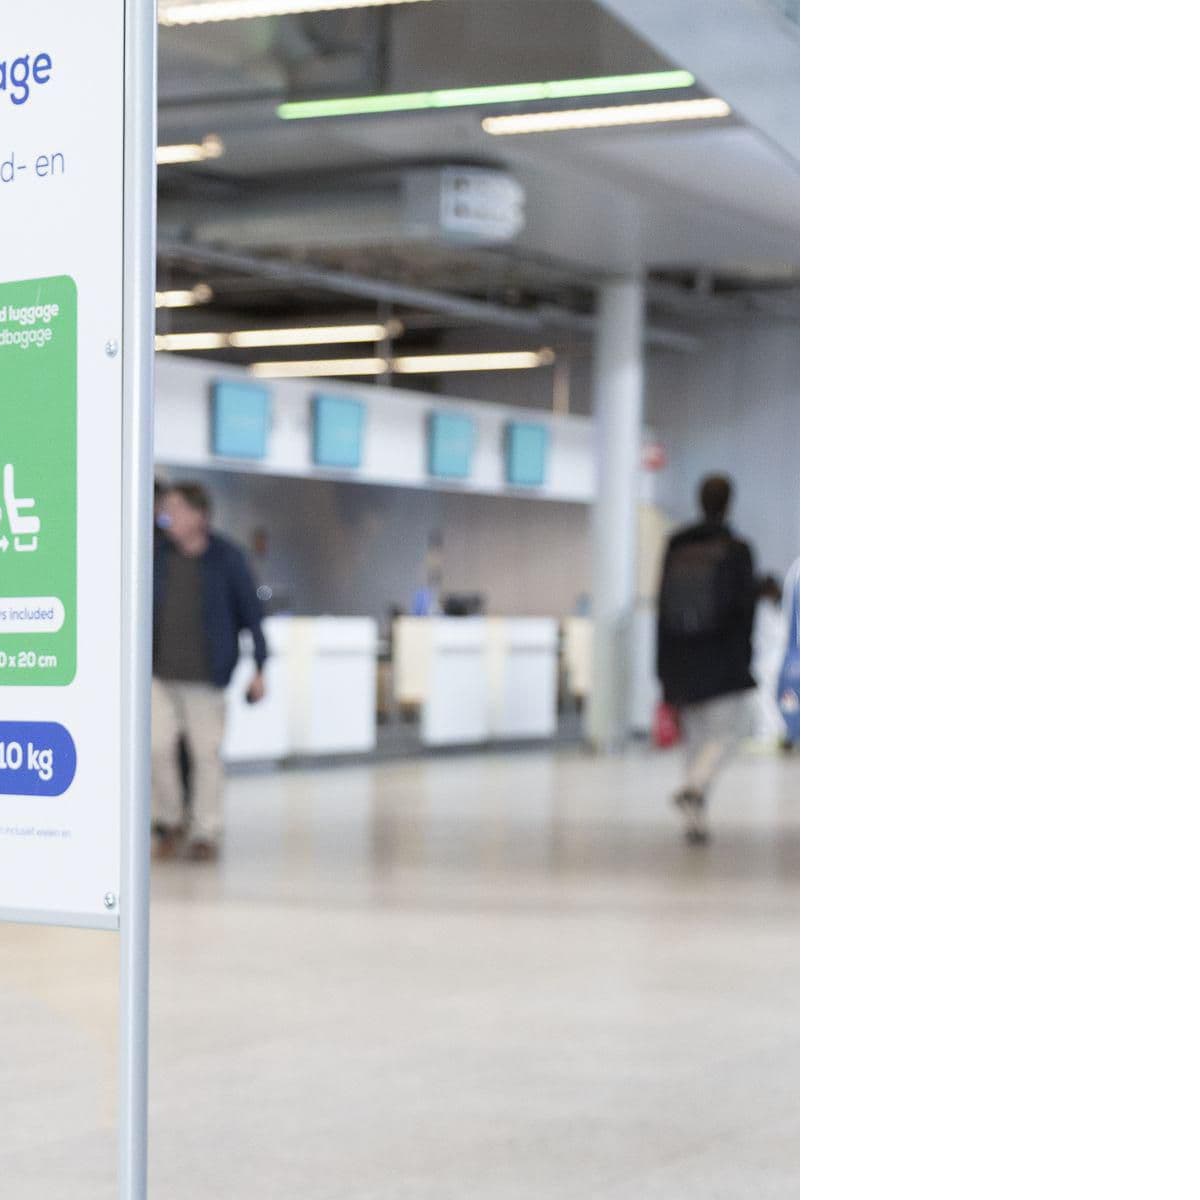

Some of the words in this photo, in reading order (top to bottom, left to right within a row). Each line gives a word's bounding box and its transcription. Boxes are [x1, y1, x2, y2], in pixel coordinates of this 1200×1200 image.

[35, 151, 65, 177] en
[8, 303, 59, 326] luggage
[9, 606, 54, 620] included
[8, 655, 16, 668] x
[18, 652, 37, 668] 20
[38, 656, 57, 668] cm
[27, 742, 54, 781] kg
